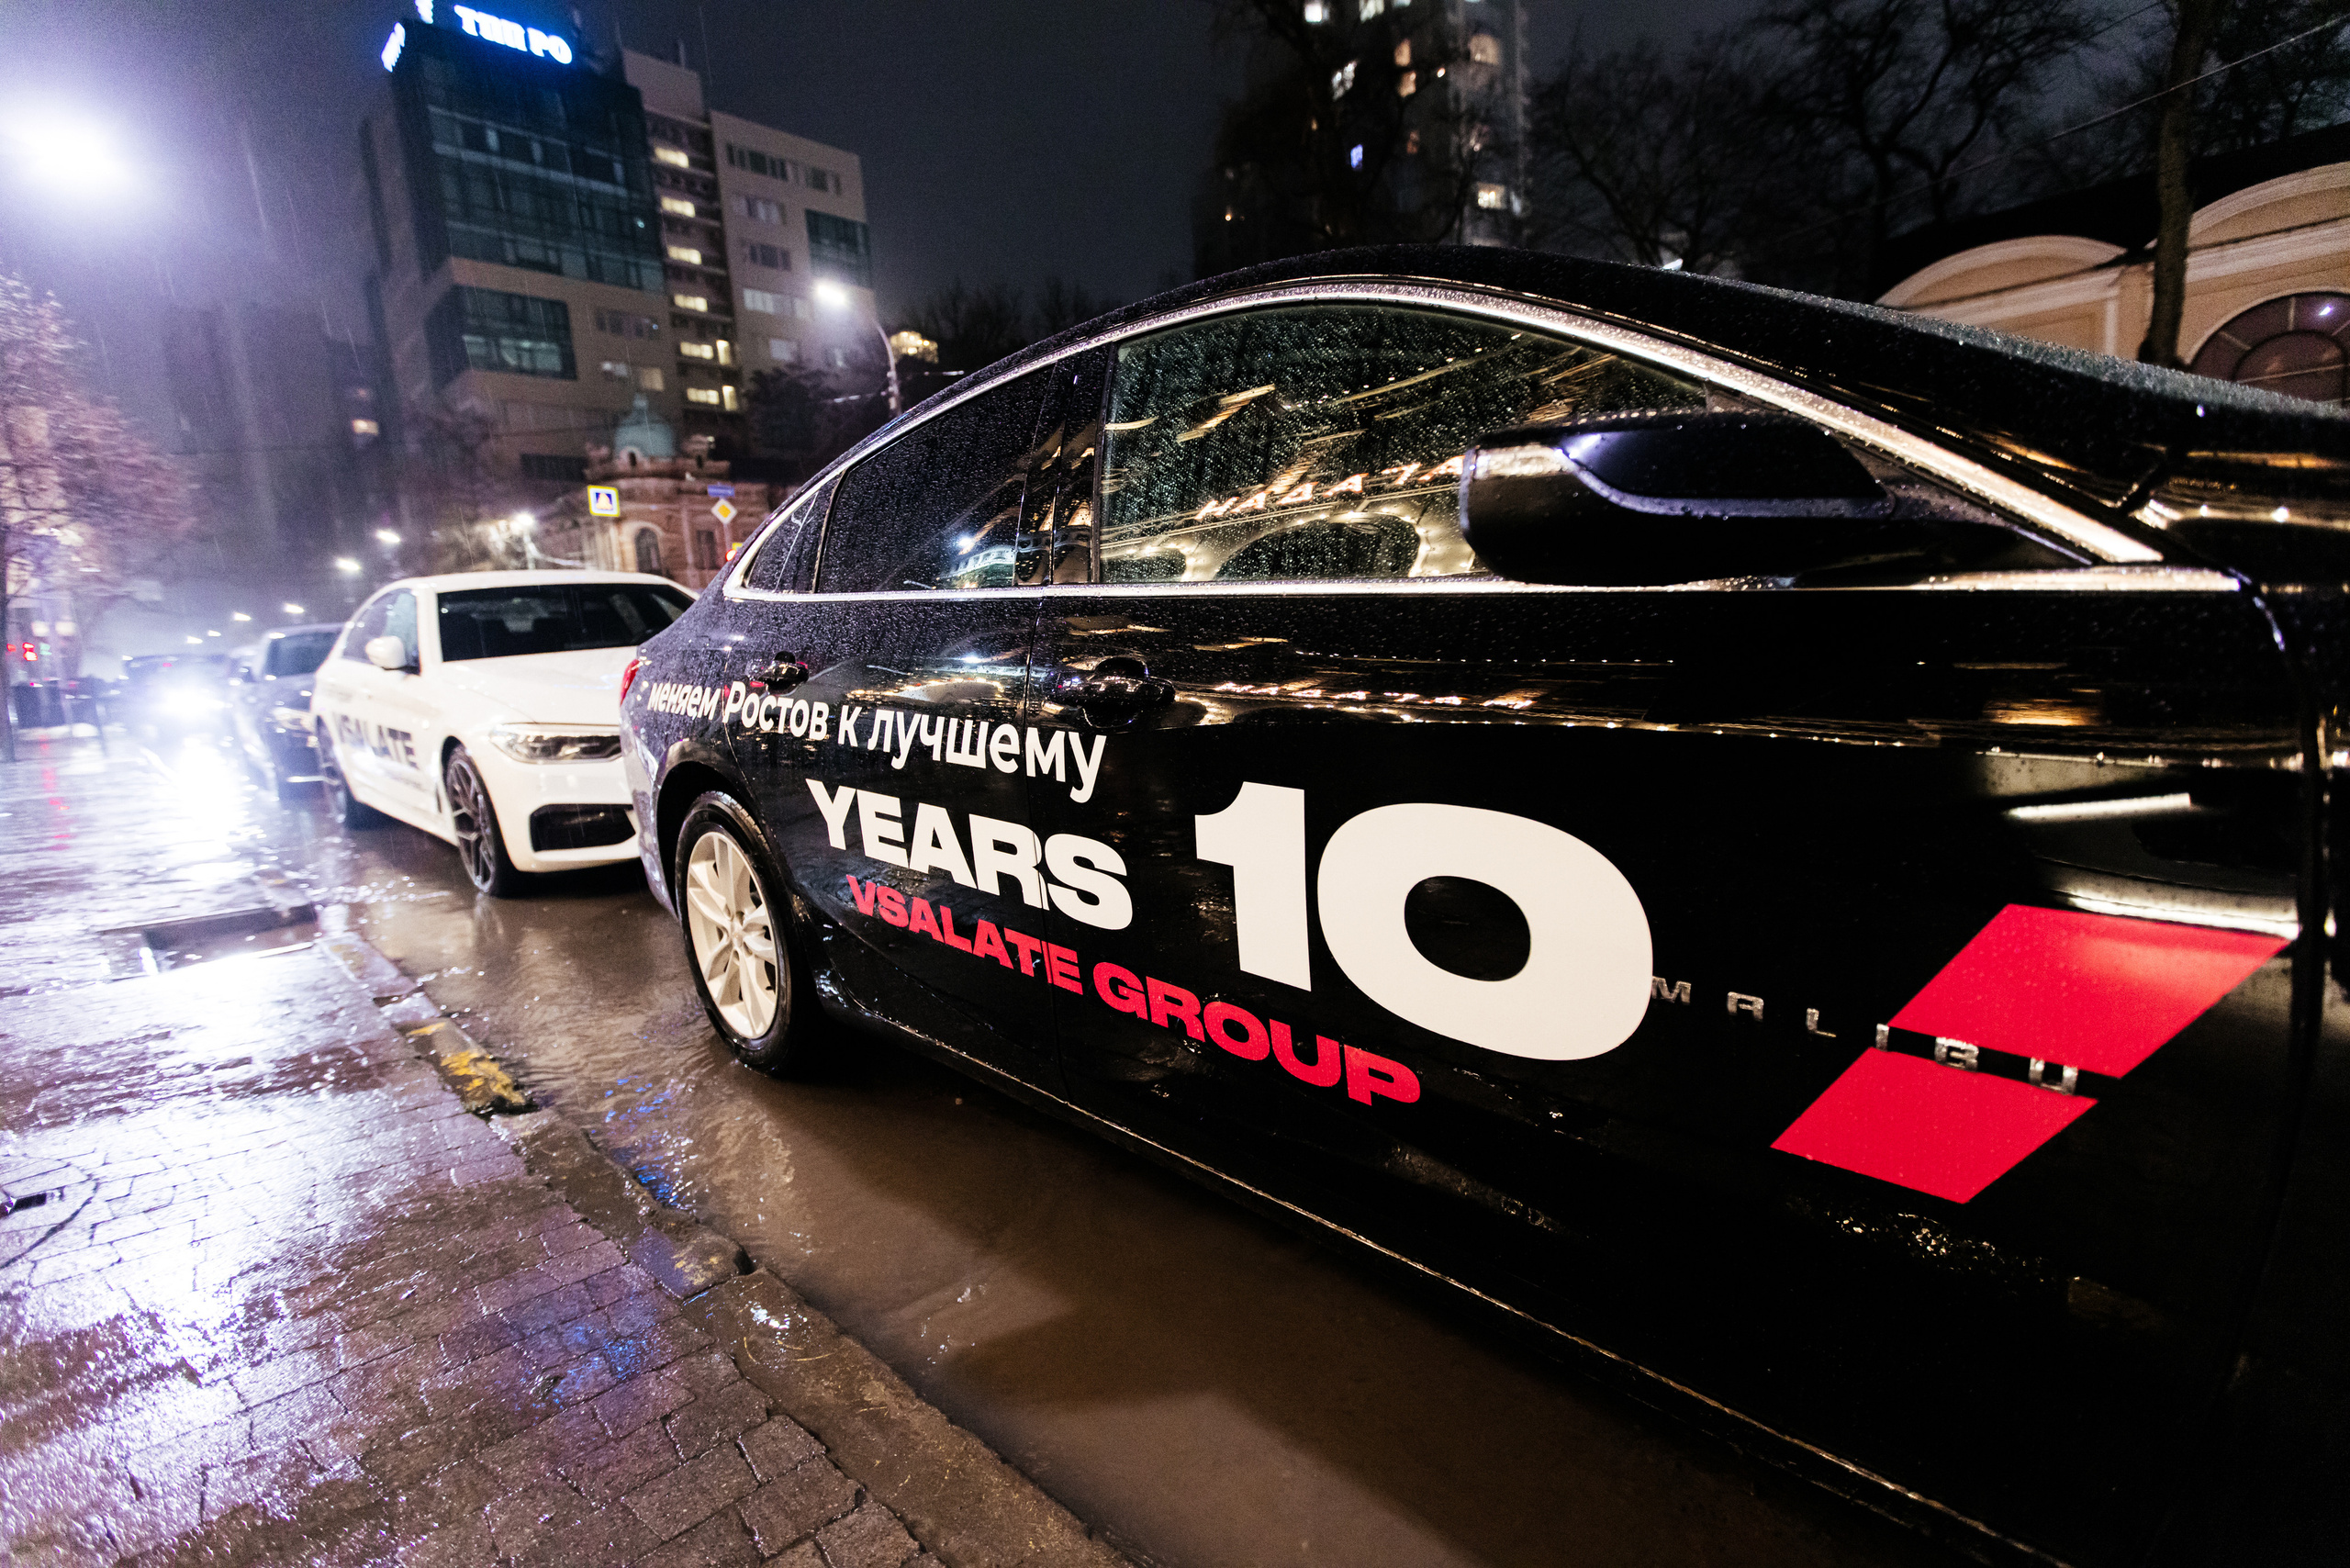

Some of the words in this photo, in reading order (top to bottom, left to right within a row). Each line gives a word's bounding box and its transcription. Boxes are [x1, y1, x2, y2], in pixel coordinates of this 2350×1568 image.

[647, 682, 722, 721] меняем
[722, 680, 830, 742] Ростов
[837, 704, 863, 748] к
[867, 709, 1107, 803] лучшему
[805, 778, 1133, 930] YEARS
[1194, 781, 1656, 1062] 10
[845, 874, 1084, 996] VSALATE
[1092, 961, 1422, 1107] GROUP
[1651, 975, 2078, 1095] MALIBU
